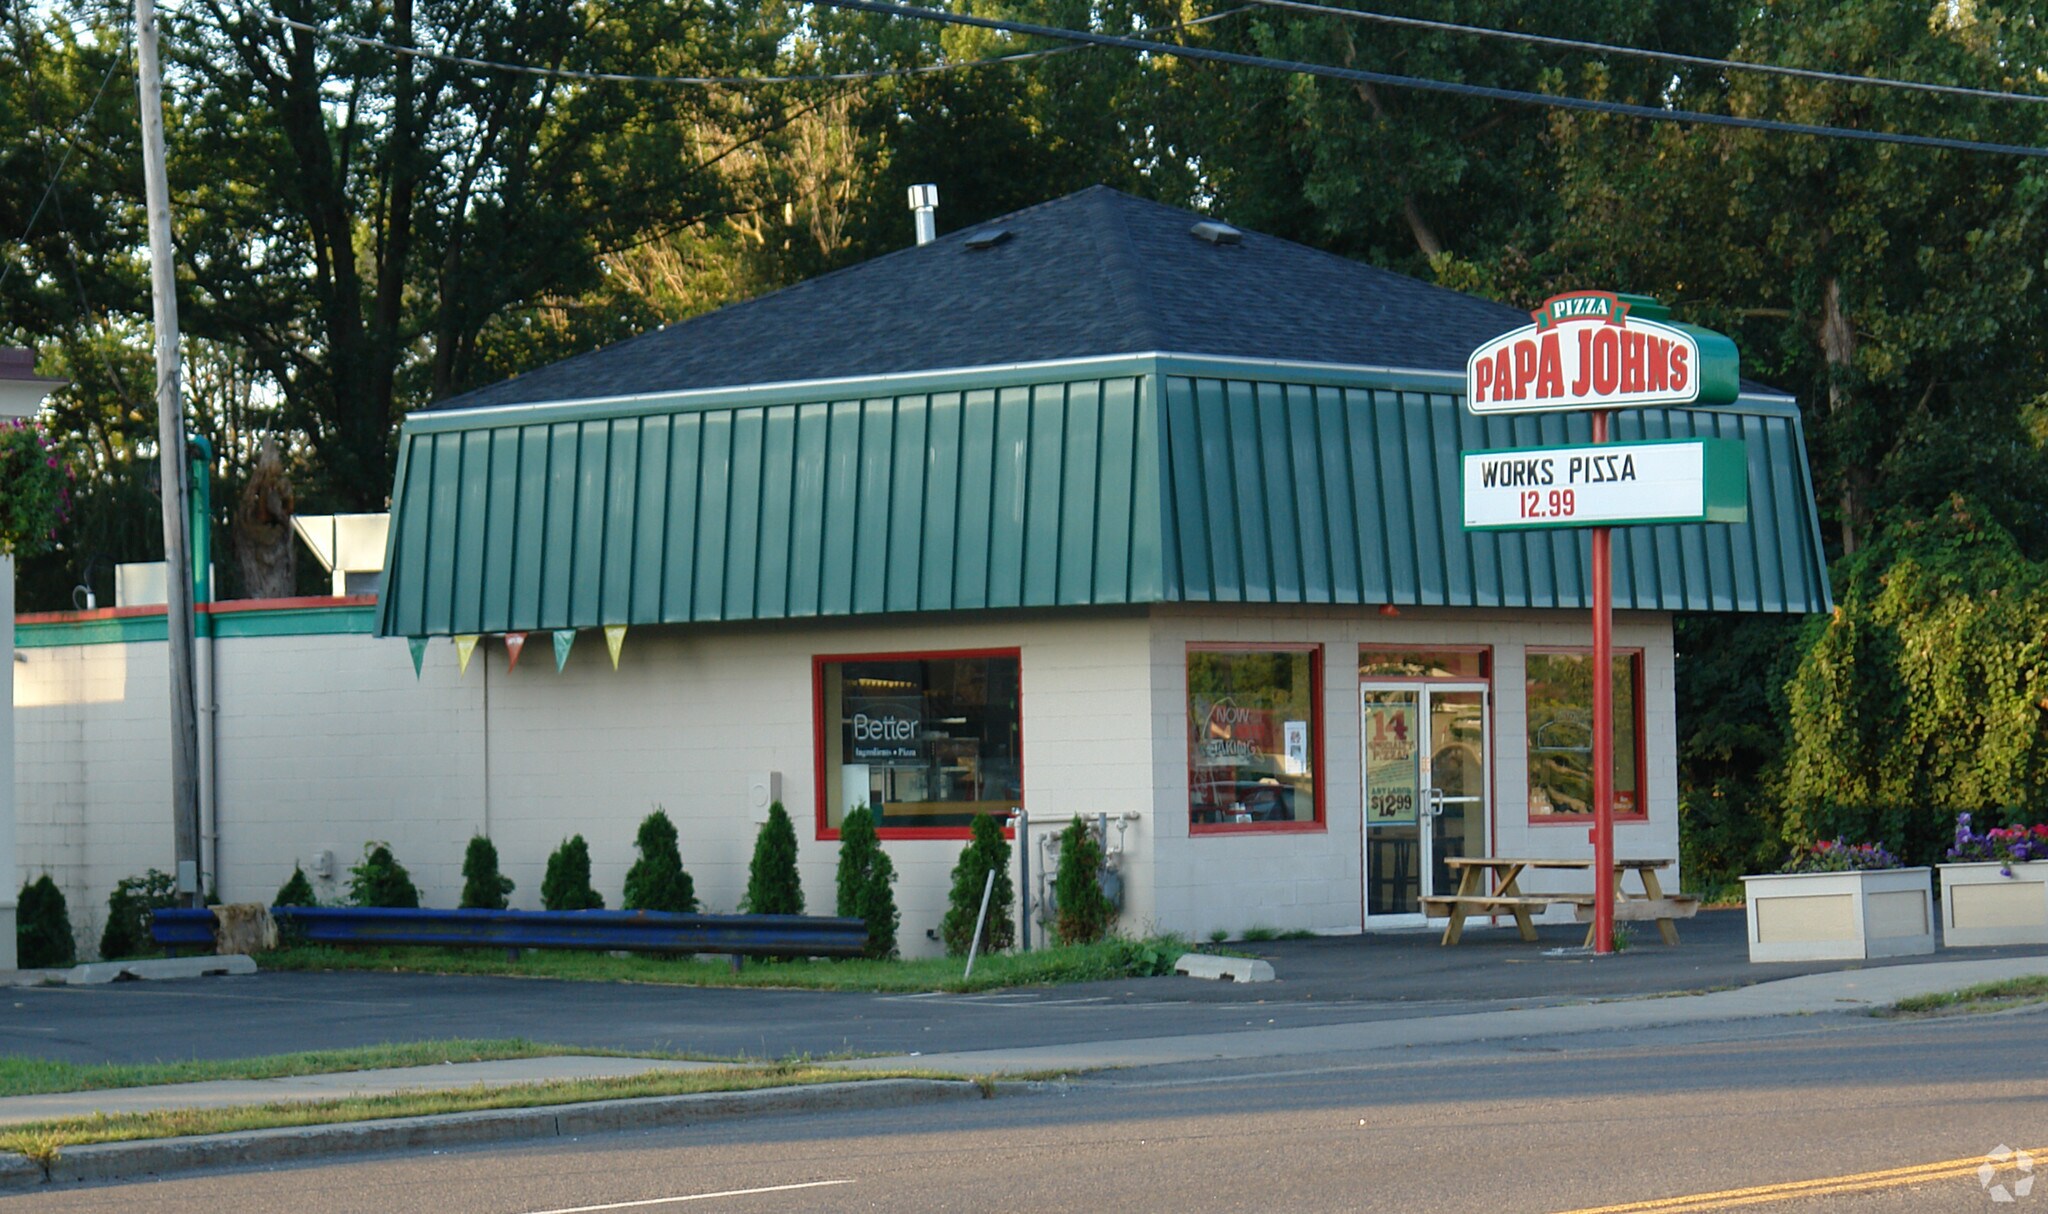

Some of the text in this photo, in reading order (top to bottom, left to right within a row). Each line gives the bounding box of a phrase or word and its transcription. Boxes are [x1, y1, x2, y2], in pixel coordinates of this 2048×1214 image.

[1553, 298, 1608, 319] PIZZA
[1475, 327, 1689, 403] PAPA JOHN'S
[1481, 453, 1637, 488] WORKS PIZZA
[1520, 488, 1575, 519] 12.99
[854, 713, 919, 740] Better
[1216, 707, 1250, 724] NOW
[1372, 709, 1409, 743] 14
